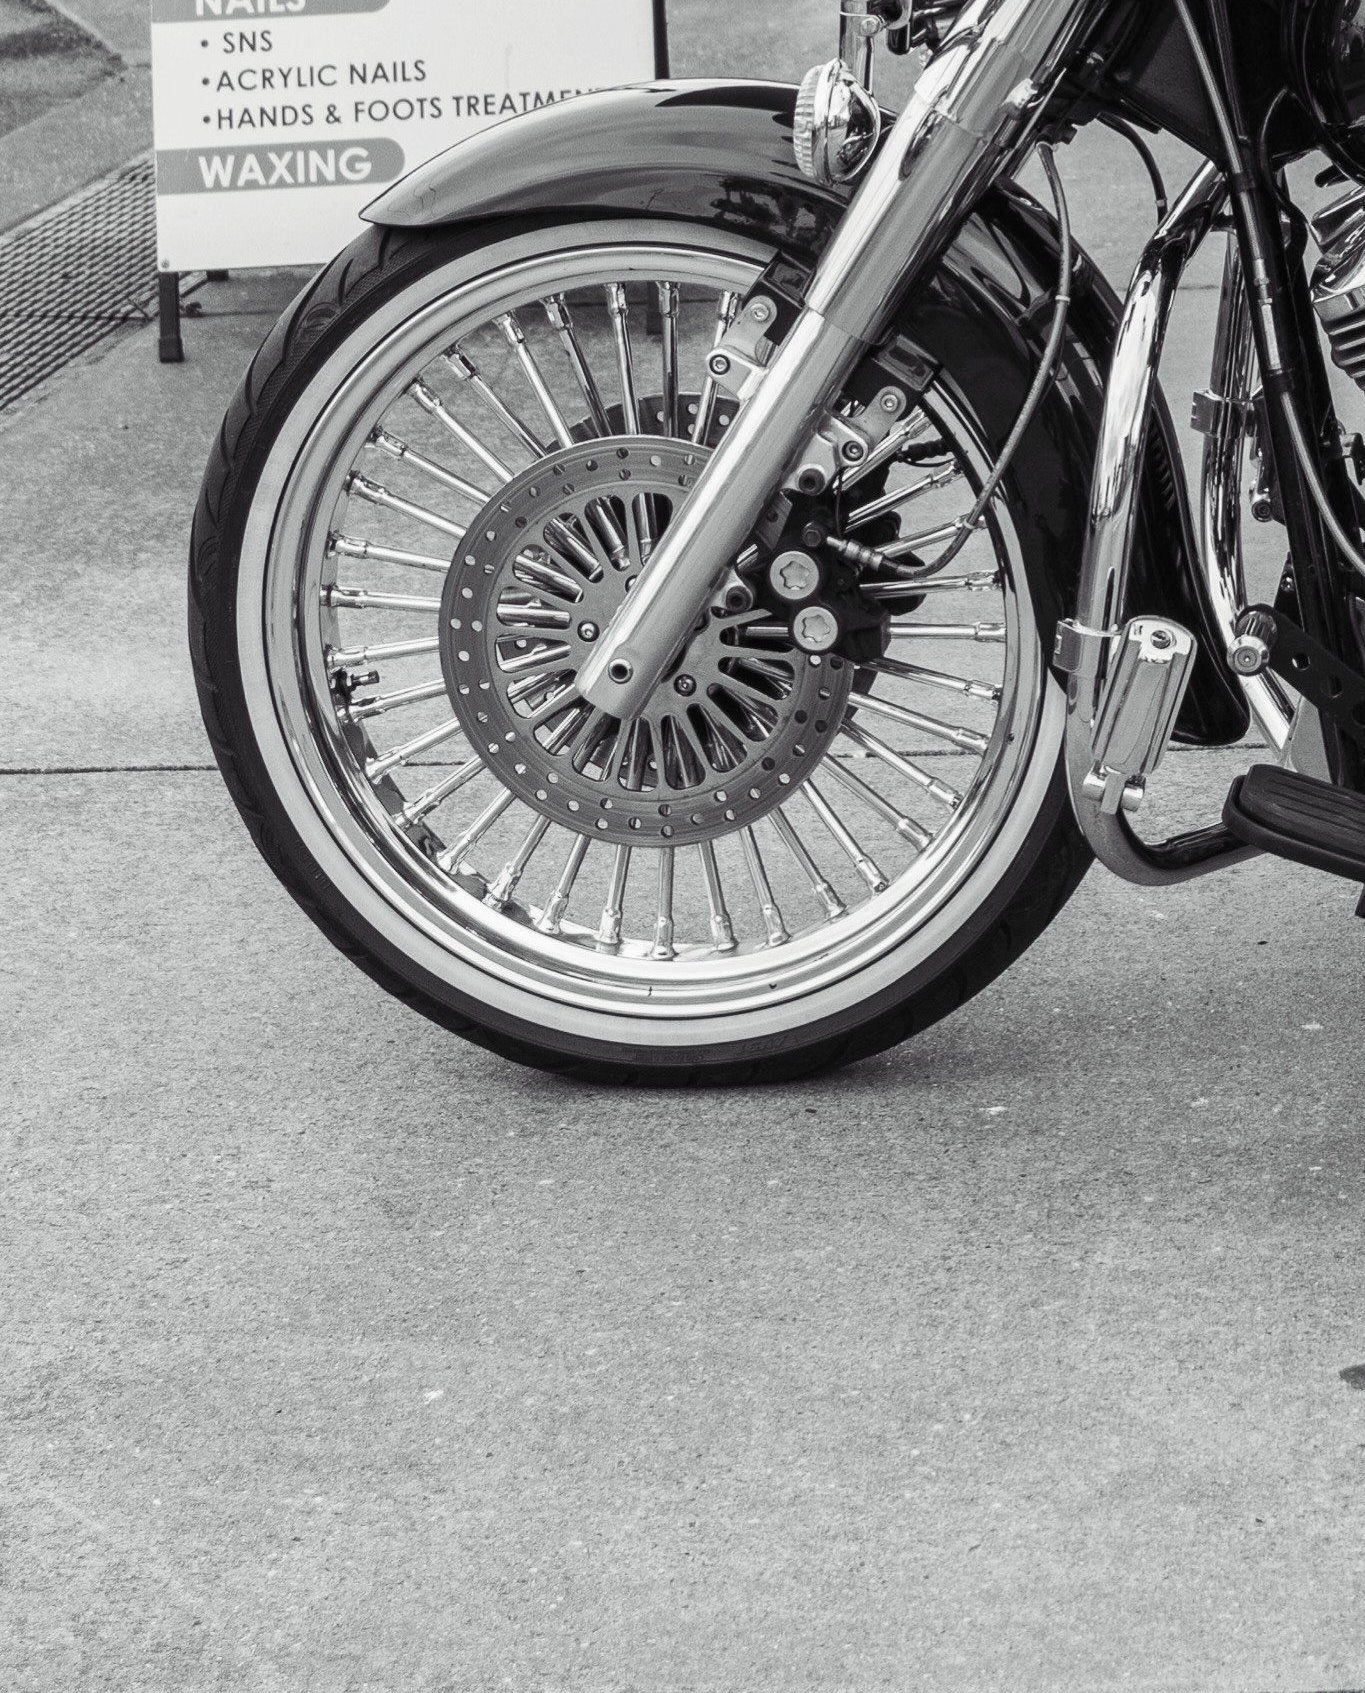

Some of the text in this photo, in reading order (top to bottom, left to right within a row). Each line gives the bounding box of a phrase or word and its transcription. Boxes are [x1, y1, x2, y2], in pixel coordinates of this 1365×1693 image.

[222, 30, 274, 54] SNS
[216, 60, 427, 92] ACRYLIC NAILS
[216, 103, 315, 130] HANDS
[325, 103, 342, 125] &
[354, 97, 443, 123] FOOTS
[198, 146, 373, 188] WAXING
